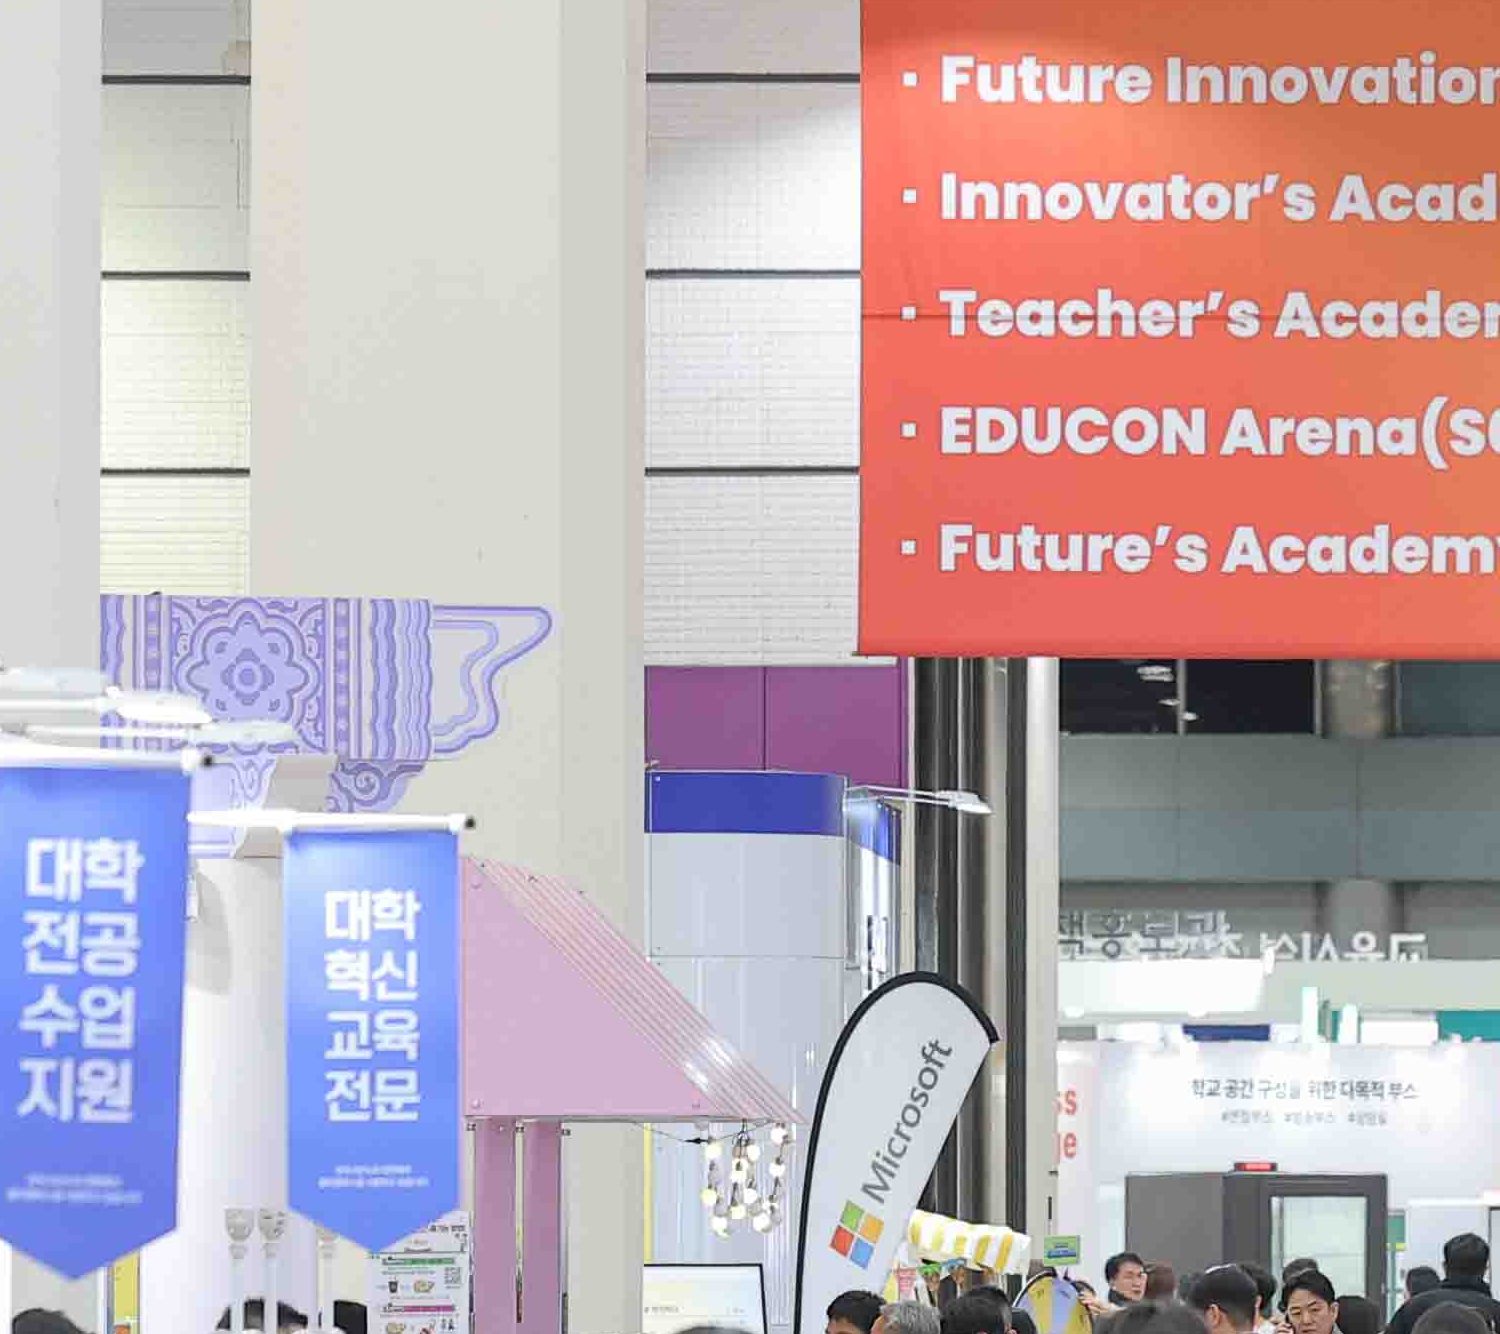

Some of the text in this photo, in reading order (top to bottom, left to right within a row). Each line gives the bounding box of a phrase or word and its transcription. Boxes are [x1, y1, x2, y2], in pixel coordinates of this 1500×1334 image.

[942, 56, 1151, 103] Future
[942, 173, 1315, 220] Innovator's
[940, 289, 1259, 337] Teacher's
[942, 407, 1205, 454] EDUCON
[941, 525, 1207, 572] Future's
[26, 838, 143, 903] 대학
[324, 889, 422, 942] 대학
[22, 909, 142, 978] 전공
[323, 948, 420, 1002] 혁신
[18, 983, 137, 1051] 수업
[323, 1011, 421, 1063] 교육
[16, 1057, 134, 1123] 지원
[323, 1069, 421, 1123] 전문
[860, 1038, 953, 1205] Microsoft
